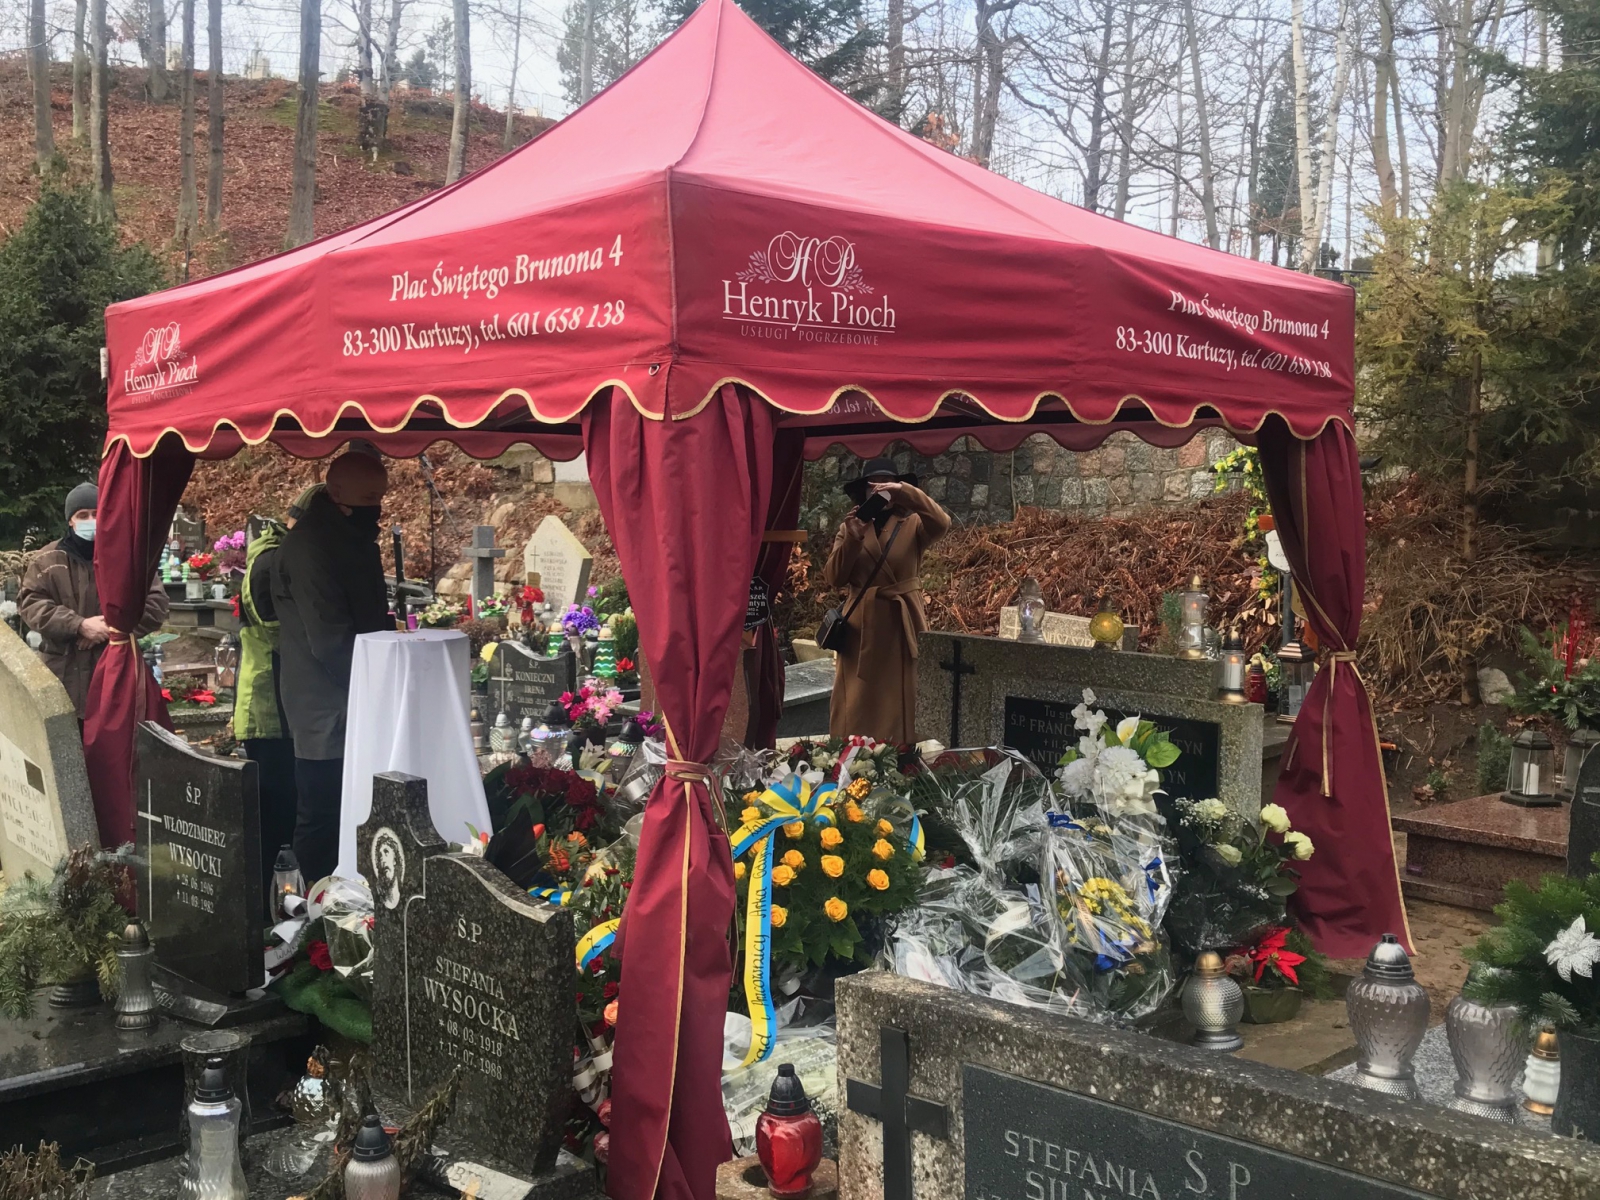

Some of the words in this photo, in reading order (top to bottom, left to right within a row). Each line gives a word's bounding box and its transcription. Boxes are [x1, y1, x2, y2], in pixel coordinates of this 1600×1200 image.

[390, 270, 428, 302] Plac
[431, 261, 508, 299] Świętego
[514, 247, 603, 285] Brunona
[609, 234, 623, 266] 4
[342, 325, 401, 357] 83-300
[402, 320, 480, 354] Kartuzy,
[480, 314, 506, 340] tel.
[507, 311, 539, 338] 601
[545, 304, 584, 334] 658
[585, 299, 625, 329] 138
[722, 279, 823, 332] Henryk
[831, 291, 896, 328] Pioch
[1167, 289, 1203, 314] Plac
[1200, 293, 1258, 335] Świętego
[1262, 309, 1318, 339] Brunona
[1320, 319, 1329, 340] 4
[741, 324, 788, 340] USŁUGI
[799, 330, 880, 346] POGRZEBOWE
[1116, 325, 1172, 356] 83-300
[1176, 334, 1238, 372] Kartuzy,
[1240, 348, 1258, 369] tel.
[1261, 351, 1288, 372] 601
[124, 363, 166, 395] Henryk
[167, 355, 198, 385] Pioch
[514, 670, 555, 684] KONIECZNI
[523, 685, 546, 695] IRENA
[169, 841, 222, 878] WYSOCKI
[435, 955, 505, 1000] STEFANIA
[423, 976, 520, 1041] WYSOCKA
[1004, 1129, 1161, 1200] STEFANIA
